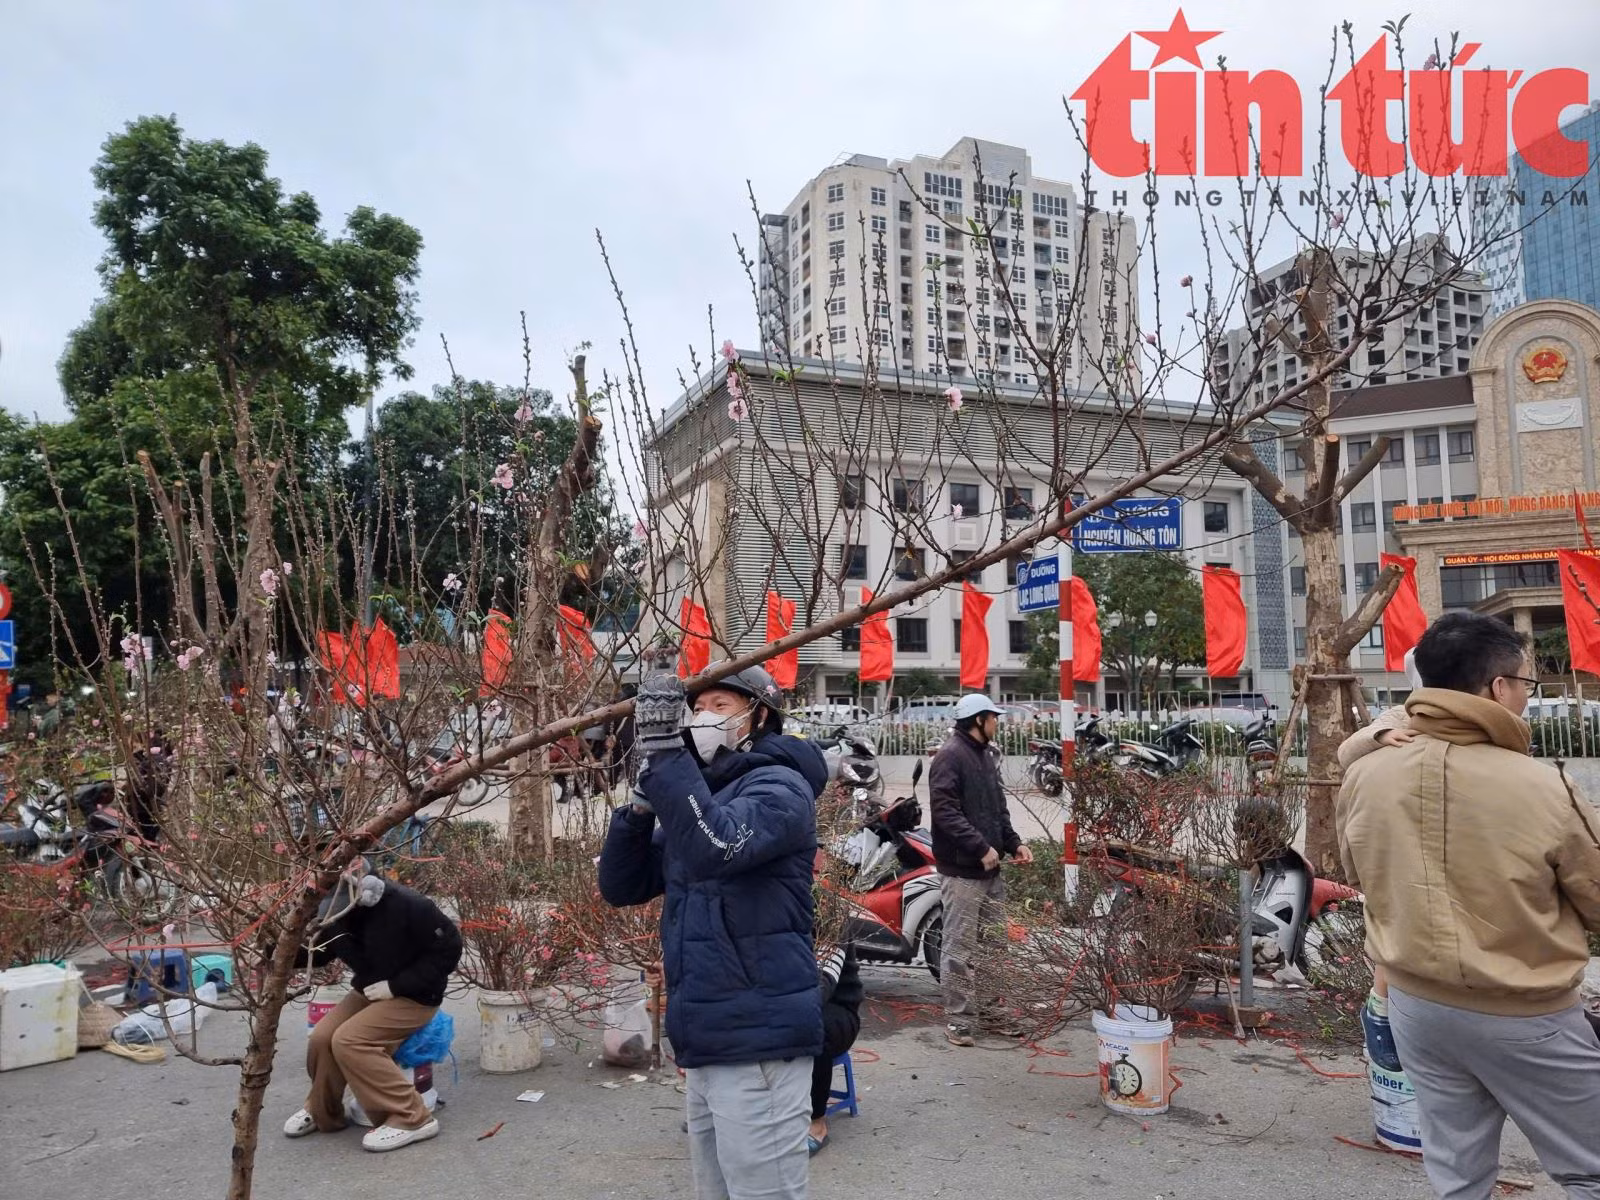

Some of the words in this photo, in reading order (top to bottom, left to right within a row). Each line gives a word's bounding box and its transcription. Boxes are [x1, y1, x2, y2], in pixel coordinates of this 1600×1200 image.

[1084, 524, 1121, 546] NGUYỄN
[1123, 526, 1156, 546] HOÀNG
[1158, 525, 1177, 545] TÔN
[1031, 563, 1056, 578] ĐƯỜNG
[1019, 588, 1029, 608] LẠC
[687, 794, 703, 819] OTHERS
[1372, 1070, 1404, 1091] Rober
